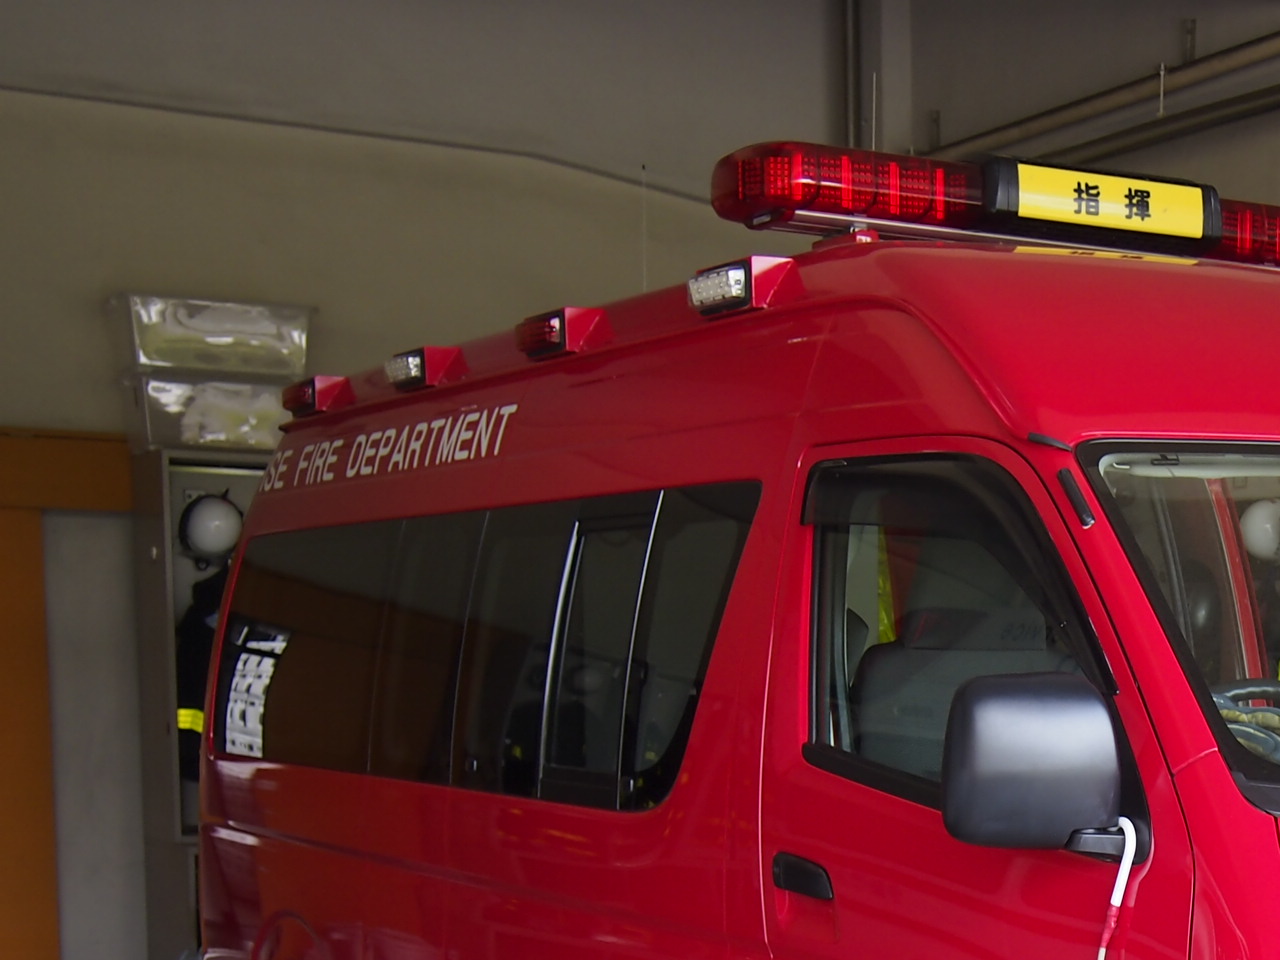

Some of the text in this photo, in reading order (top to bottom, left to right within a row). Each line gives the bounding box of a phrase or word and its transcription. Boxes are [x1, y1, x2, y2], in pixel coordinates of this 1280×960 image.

[1073, 181, 1152, 222] 指揮
[293, 438, 345, 487] FIRE
[345, 404, 519, 479] DEPARTMENT
